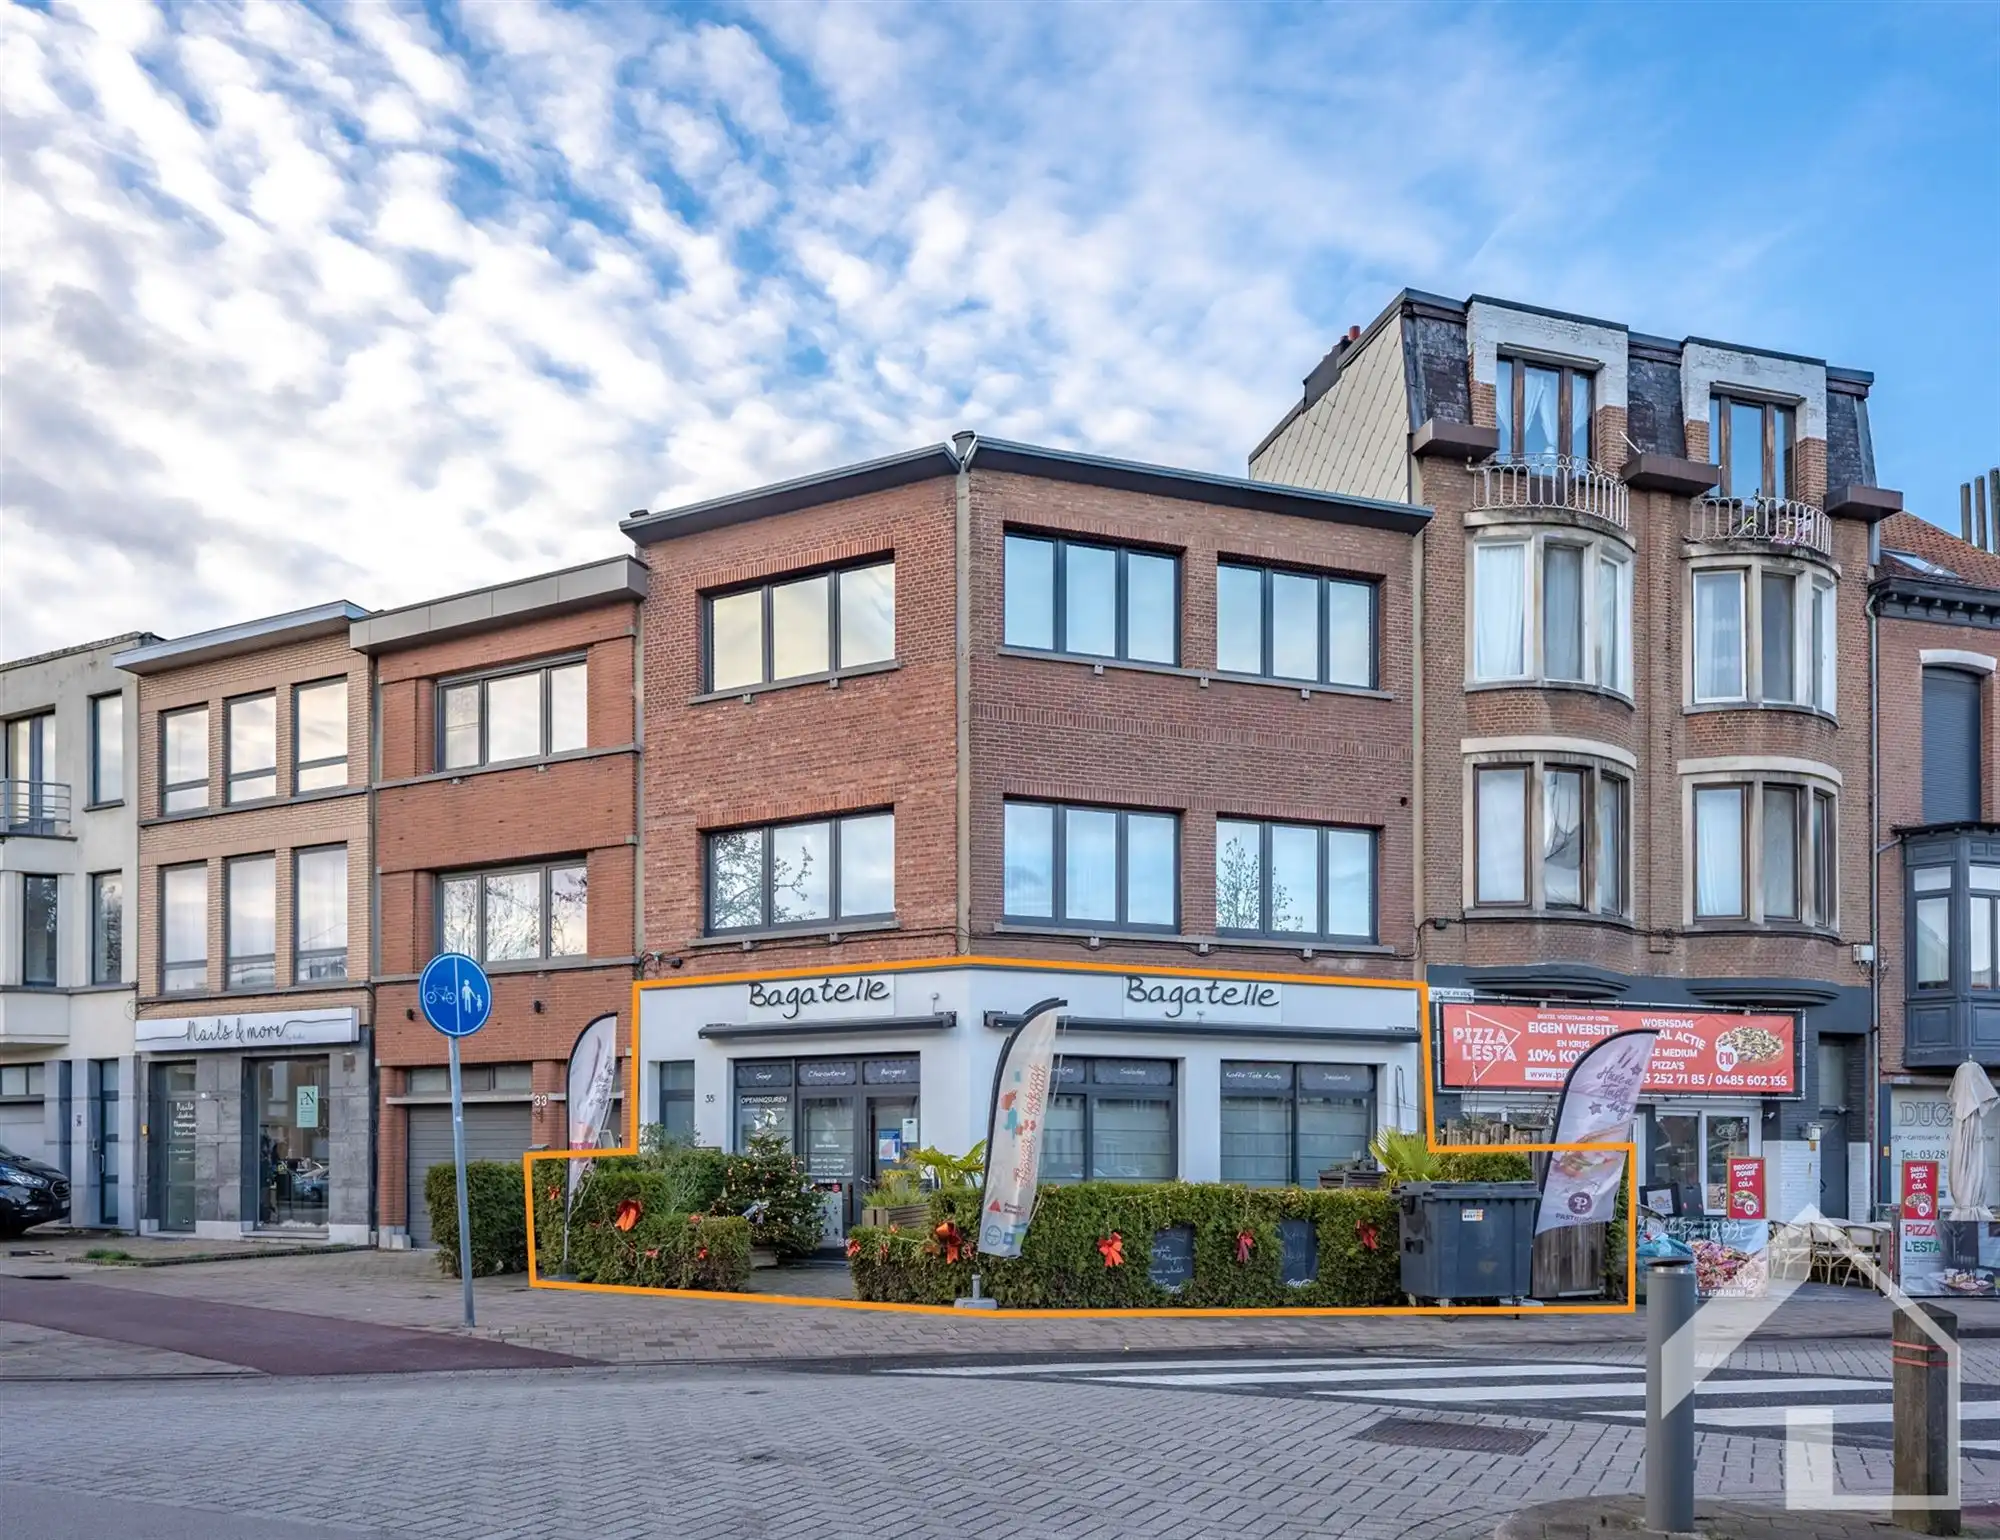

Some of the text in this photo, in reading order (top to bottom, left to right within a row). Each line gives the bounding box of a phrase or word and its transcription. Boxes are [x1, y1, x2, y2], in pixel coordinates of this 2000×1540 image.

[748, 977, 890, 1019] Bagatelle
[1125, 975, 1280, 1018] Bagatelle
[185, 1018, 232, 1042] Nails
[1528, 1022, 1563, 1034] EIGEN
[1641, 1018, 1694, 1029] WOENSDAG
[1452, 1027, 1509, 1044] PIZZA
[1655, 1029, 1706, 1051] AL ACTIE
[1462, 1045, 1518, 1062] LESTA
[1527, 1049, 1556, 1062] 10%
[1662, 1048, 1698, 1058] MEDIUM
[1652, 1061, 1685, 1070] PIZZA'S
[1596, 1065, 1625, 1084] Have
[1653, 1073, 1674, 1084] 252
[1676, 1074, 1688, 1085] 71
[1691, 1074, 1705, 1085] 85
[1715, 1074, 1745, 1086] 0485
[1747, 1075, 1767, 1086] 602
[534, 1094, 547, 1106] 33
[1919, 1149, 1949, 1160] 03/28
[1738, 1180, 1754, 1188] COLA
[1905, 1223, 1938, 1237] PIZZA
[1905, 1241, 1941, 1253] L'ESTA
